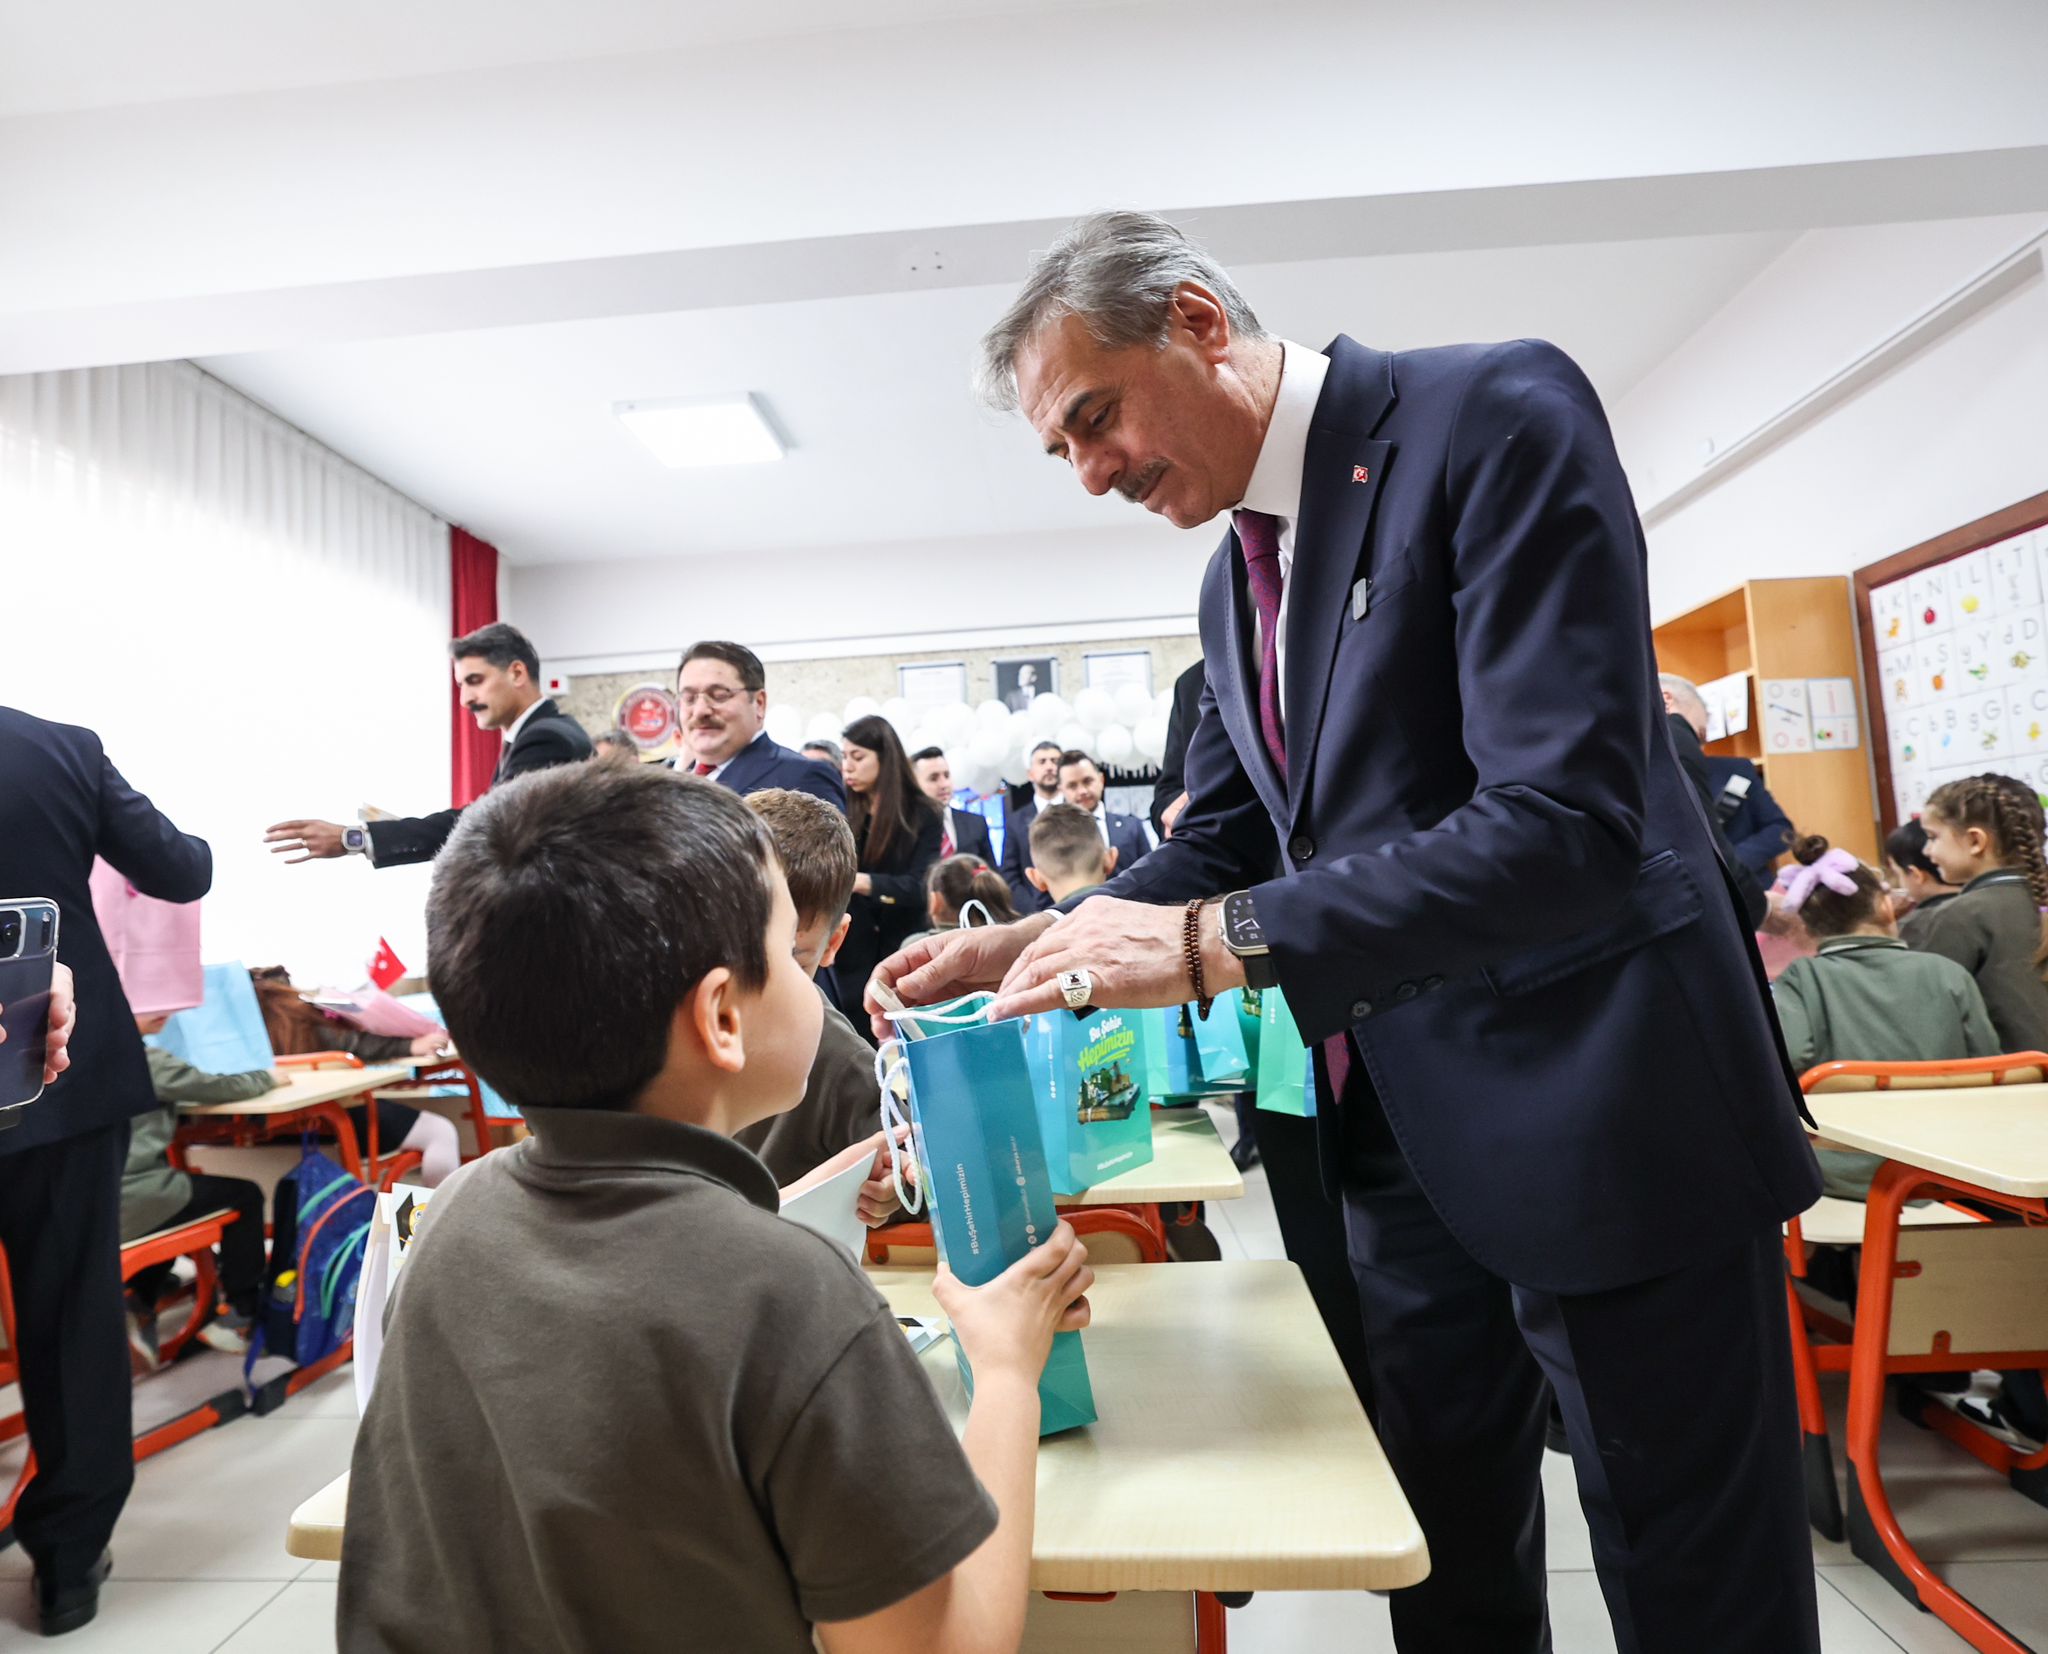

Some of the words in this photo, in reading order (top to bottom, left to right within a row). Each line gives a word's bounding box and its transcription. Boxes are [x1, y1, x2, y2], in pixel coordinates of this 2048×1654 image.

[2012, 546, 2025, 568] T
[2022, 617, 2040, 640] D
[1977, 630, 1991, 650] Y
[1937, 643, 1949, 664] S
[1982, 699, 2001, 721] G
[1078, 1026, 1135, 1073] Hepimizin
[956, 1162, 980, 1255] #BuŞehirHepimizin
